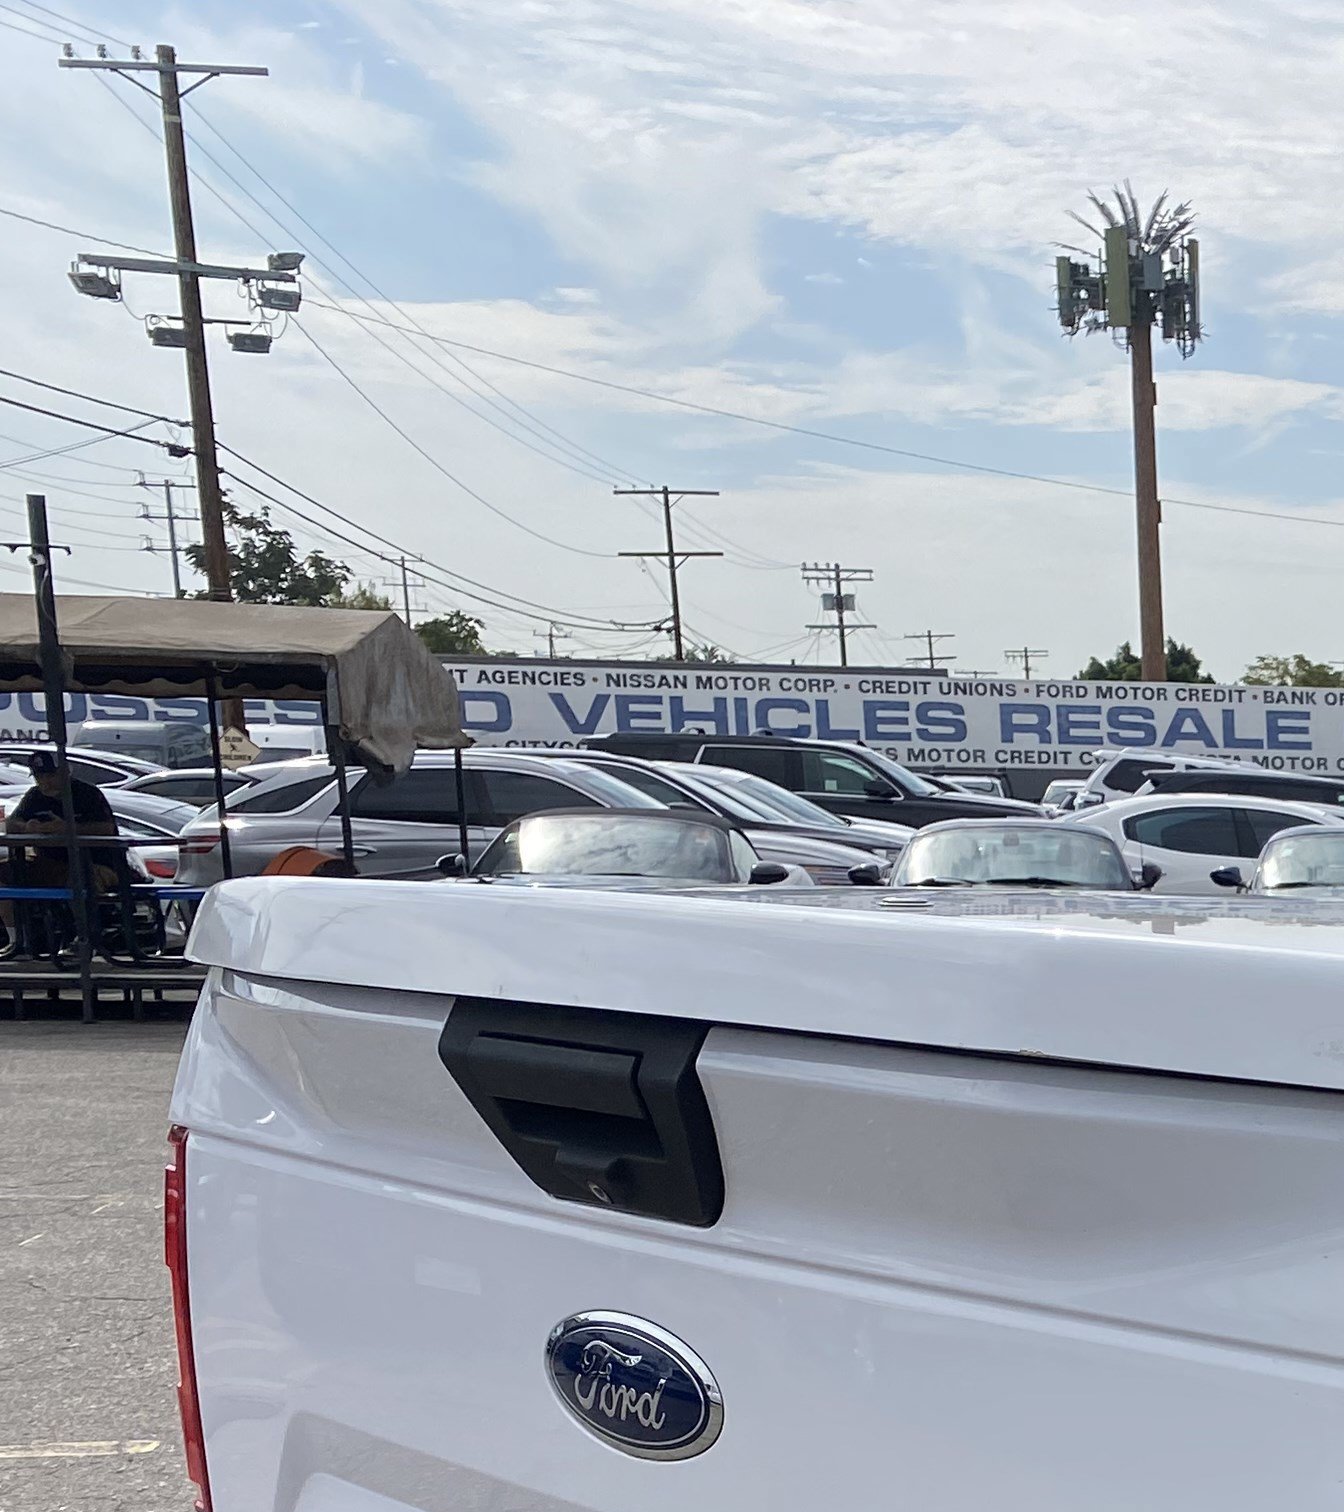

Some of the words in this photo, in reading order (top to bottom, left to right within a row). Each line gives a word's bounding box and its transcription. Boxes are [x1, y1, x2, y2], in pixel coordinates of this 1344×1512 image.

[476, 670, 586, 686] AGENCIES
[605, 673, 688, 689] NISSAN
[695, 675, 771, 691] MOTOR
[779, 677, 838, 693] CORP.
[858, 680, 931, 695] CREDIT
[938, 681, 1017, 697] UNIONS
[1035, 684, 1088, 699] FORD
[1095, 685, 1168, 701] MOTOR
[1175, 687, 1246, 703] CREDIT
[1263, 690, 1317, 705] BANK
[547, 692, 968, 743] VEHICLES
[999, 703, 1312, 750] RESALE
[907, 748, 986, 764] MOTOR
[994, 750, 1073, 765] CREDIT
[1252, 755, 1328, 771] MOTOR
[573, 1339, 668, 1431] Ford
